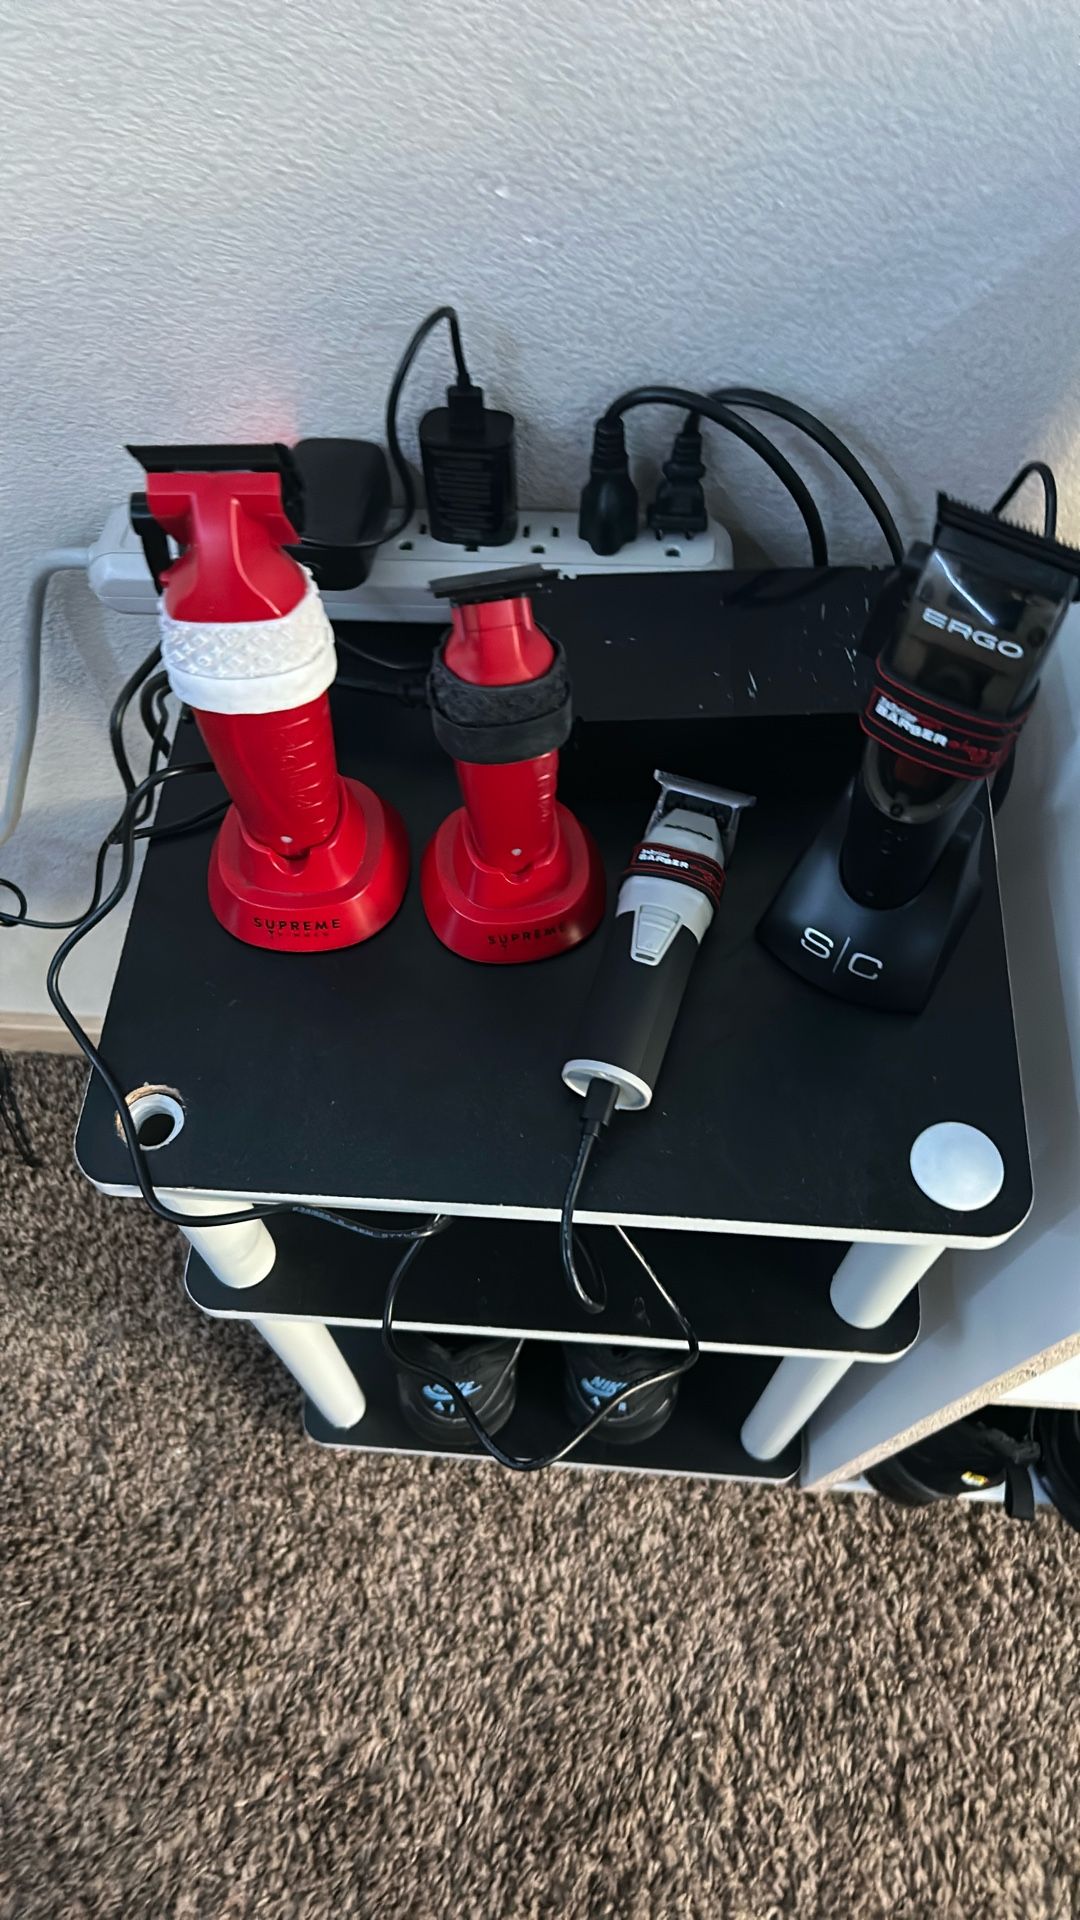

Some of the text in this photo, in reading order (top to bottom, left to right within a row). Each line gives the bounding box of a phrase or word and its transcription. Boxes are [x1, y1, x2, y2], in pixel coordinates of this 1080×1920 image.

[922, 607, 1024, 659] ERGO
[875, 703, 948, 747] BARBER
[253, 917, 341, 931] SUPREME
[487, 922, 566, 945] SUPREME
